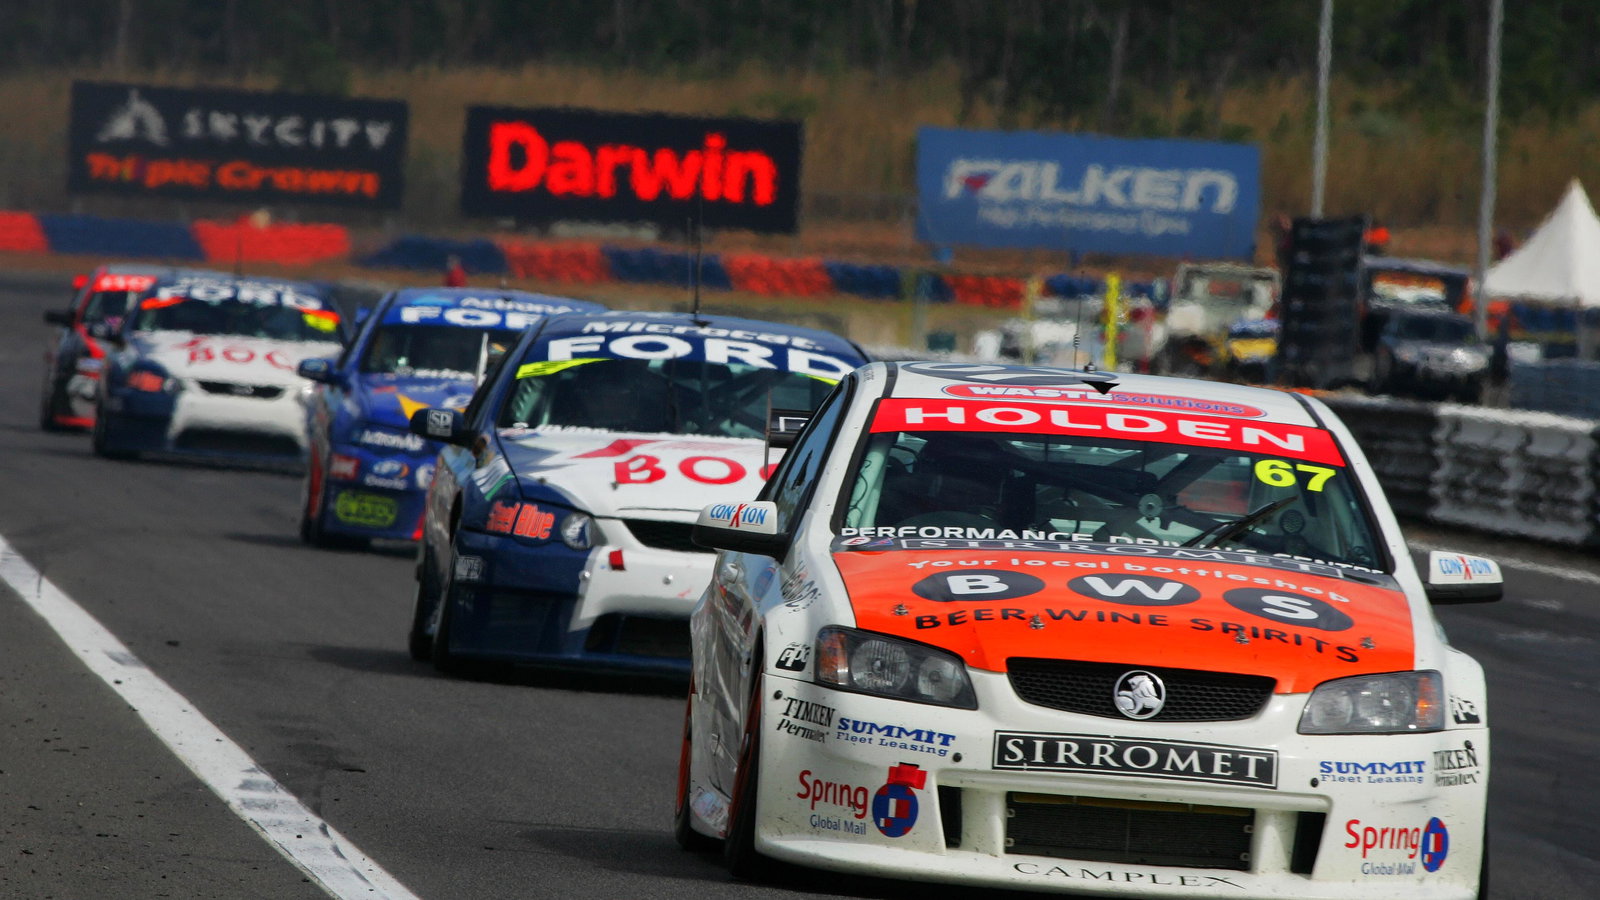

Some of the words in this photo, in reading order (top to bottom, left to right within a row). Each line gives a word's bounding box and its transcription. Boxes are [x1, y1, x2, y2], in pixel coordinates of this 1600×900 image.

[184, 109, 392, 149] SKYCITY
[216, 160, 379, 197] Crown
[487, 120, 778, 206] Darwin
[944, 158, 1239, 214] FALKEN
[157, 282, 323, 310] FORD
[186, 346, 297, 372] BOC
[548, 334, 857, 380] FORD
[904, 406, 1306, 452] HOLDEN
[1254, 459, 1337, 493] 67
[513, 503, 555, 540] Blue
[841, 526, 1095, 543] PERFORMANCE
[907, 559, 998, 569] Your
[1011, 558, 1111, 569] local
[1123, 562, 1350, 603] bottleshop
[946, 574, 1009, 595] B
[1082, 576, 1184, 600] W
[1261, 595, 1319, 620] S
[915, 608, 1028, 630] BEER
[1045, 608, 1170, 627] WINE
[1190, 617, 1360, 663] SPIRITS
[784, 697, 836, 728] TIMKEN
[836, 731, 874, 745] Fleet
[879, 738, 949, 758] Leasing
[838, 717, 957, 747] SUMMIT
[1003, 737, 1268, 780] SIRROMET
[1319, 760, 1427, 775] SUMMIT
[796, 769, 869, 820] Spring
[1321, 773, 1362, 784] Fleet
[1367, 774, 1425, 785] Leasing
[810, 813, 841, 831] Global
[843, 819, 867, 836] Mail
[1344, 819, 1421, 860] Spring
[1013, 861, 1247, 890] CAMPLEX
[1360, 861, 1396, 876] Global
